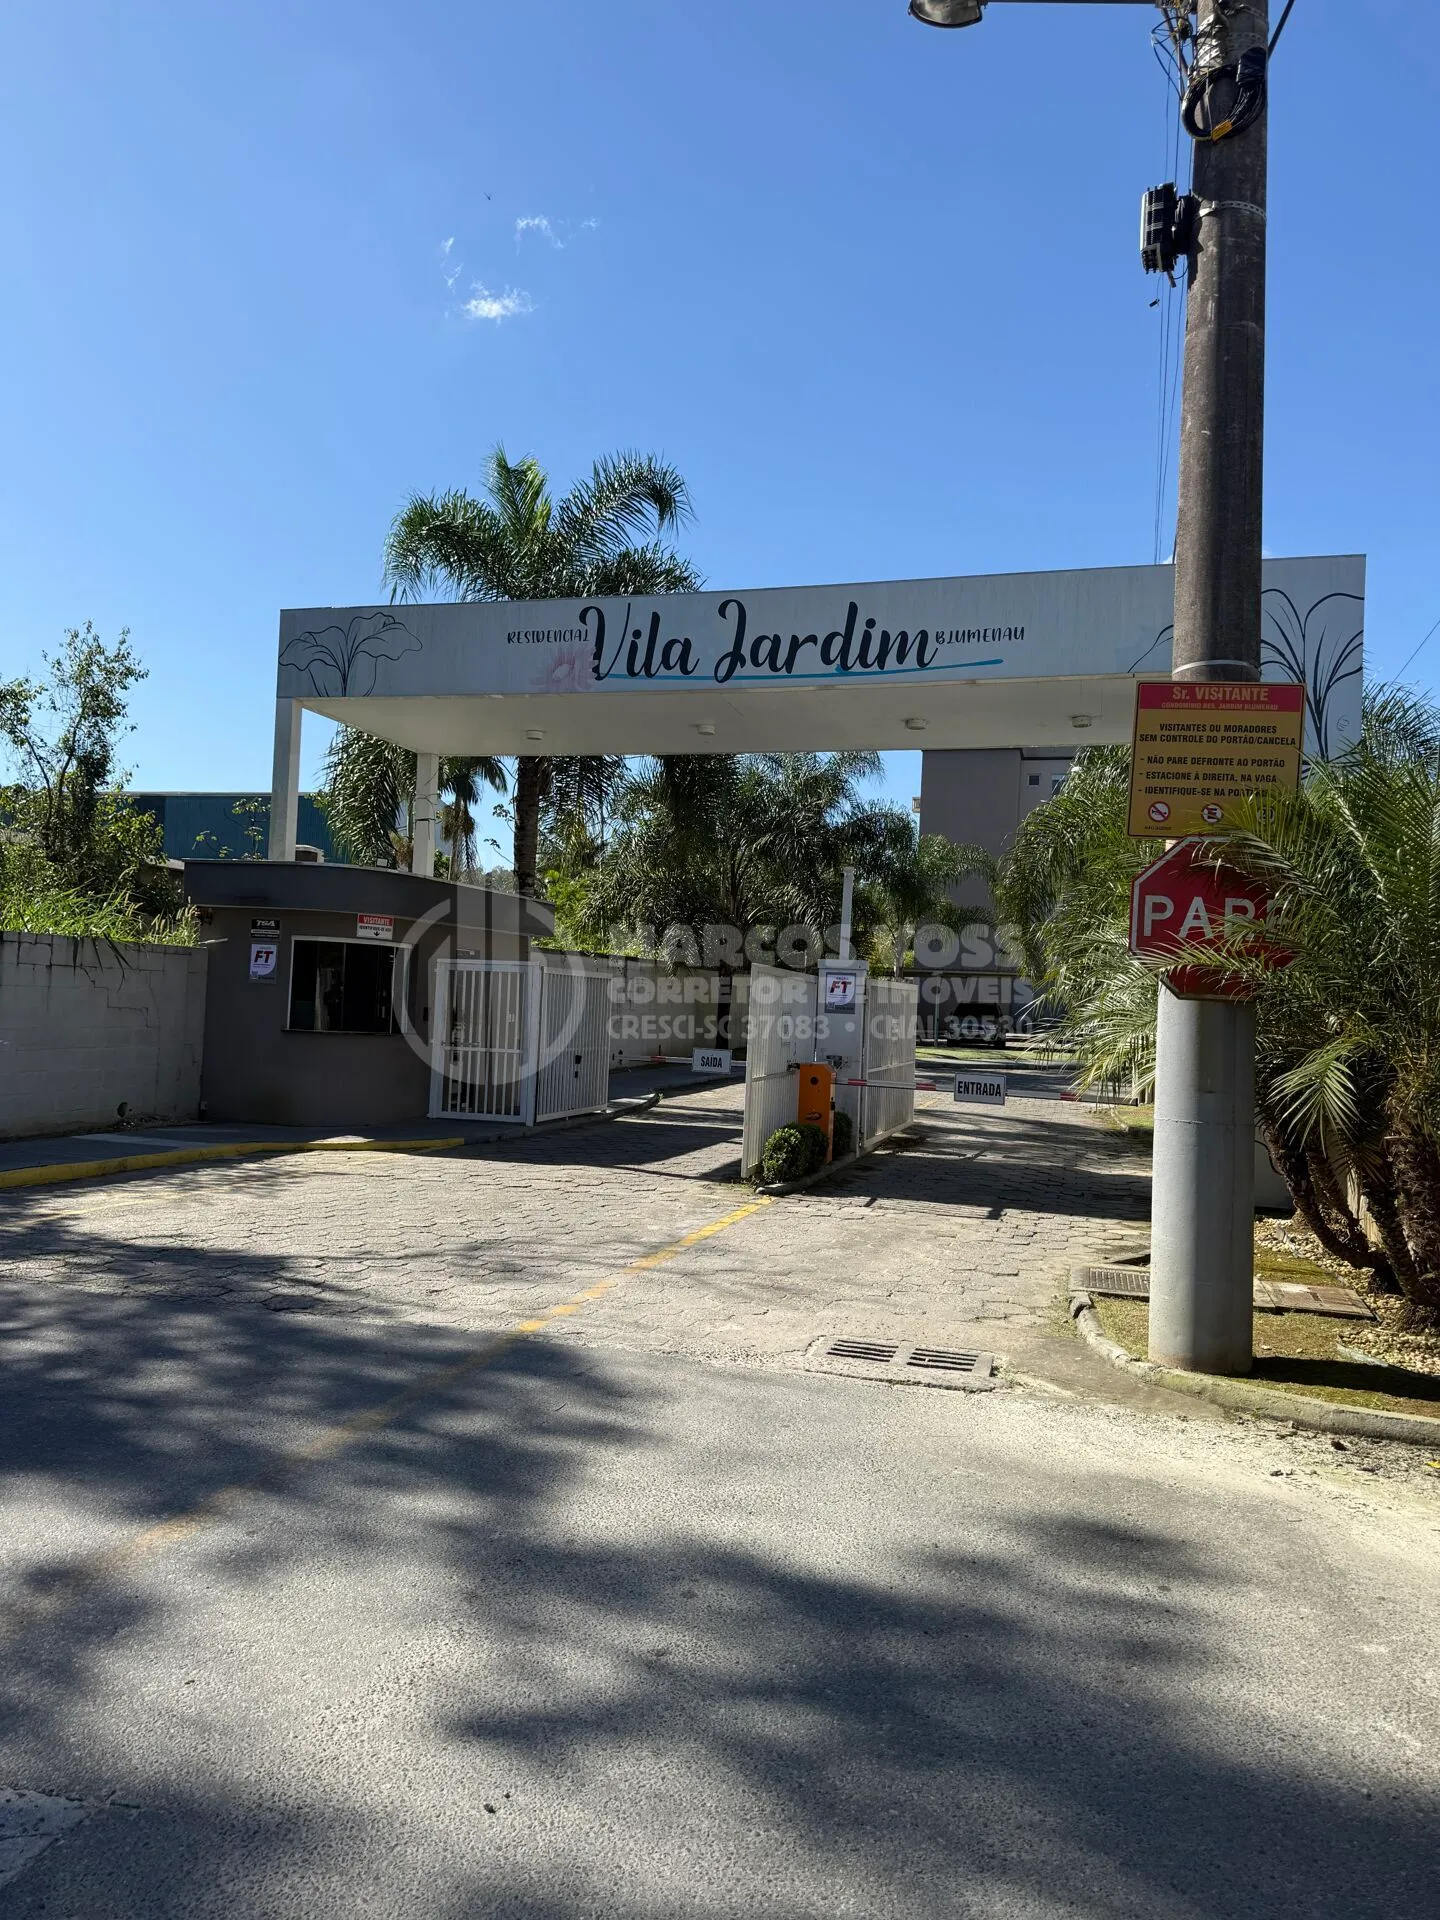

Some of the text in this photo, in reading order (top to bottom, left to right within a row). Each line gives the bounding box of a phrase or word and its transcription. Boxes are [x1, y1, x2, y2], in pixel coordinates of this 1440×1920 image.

[507, 628, 590, 645] RESIDENCIAL
[578, 598, 939, 684] Vila Jardim
[935, 626, 1025, 645] BLUMENAU
[1172, 686, 1269, 701] Sr. VISITANTE
[1159, 723, 1277, 734] VISITANTES OU MORADORES
[1139, 733, 1296, 746] SEM CONTROLE DO PORTÃO/CANCELA
[1146, 755, 1164, 765] NÃO
[1167, 756, 1188, 765] PARE
[1190, 757, 1235, 766] DEFRONTE
[1236, 758, 1249, 767] AO
[1251, 758, 1285, 768] PORTÃO
[1145, 771, 1192, 780] ESTACIONE
[1240, 773, 1252, 782] NA
[1254, 774, 1277, 783] VAGA
[1144, 786, 1211, 796] IDENTIFIQUE-SE
[1213, 788, 1226, 797] NA
[254, 950, 275, 963] FT
[829, 980, 852, 994] FT
[700, 1053, 723, 1069] SAÍDA
[957, 1080, 1002, 1098] ENTRADA
